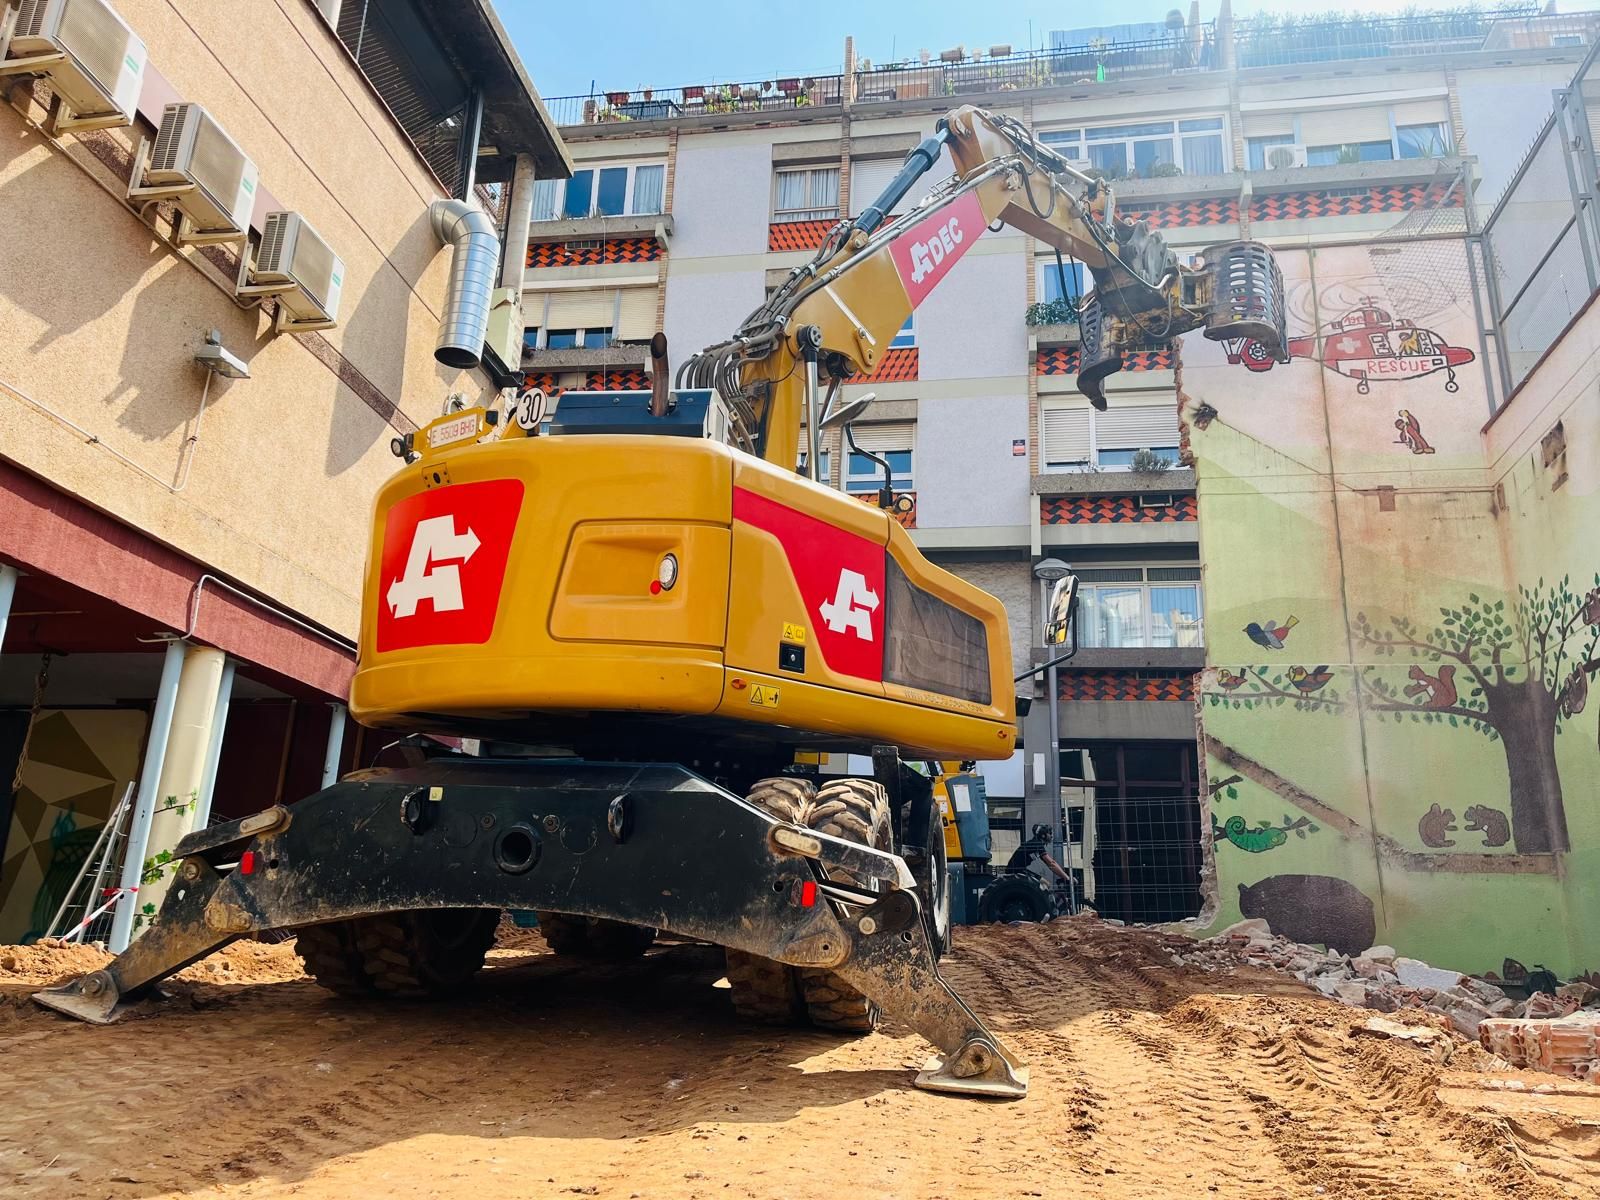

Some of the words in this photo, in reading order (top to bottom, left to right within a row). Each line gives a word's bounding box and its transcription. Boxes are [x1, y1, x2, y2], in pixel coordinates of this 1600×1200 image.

[909, 216, 964, 284] ADEC
[1367, 359, 1431, 375] RESCUE
[520, 392, 542, 425] 30
